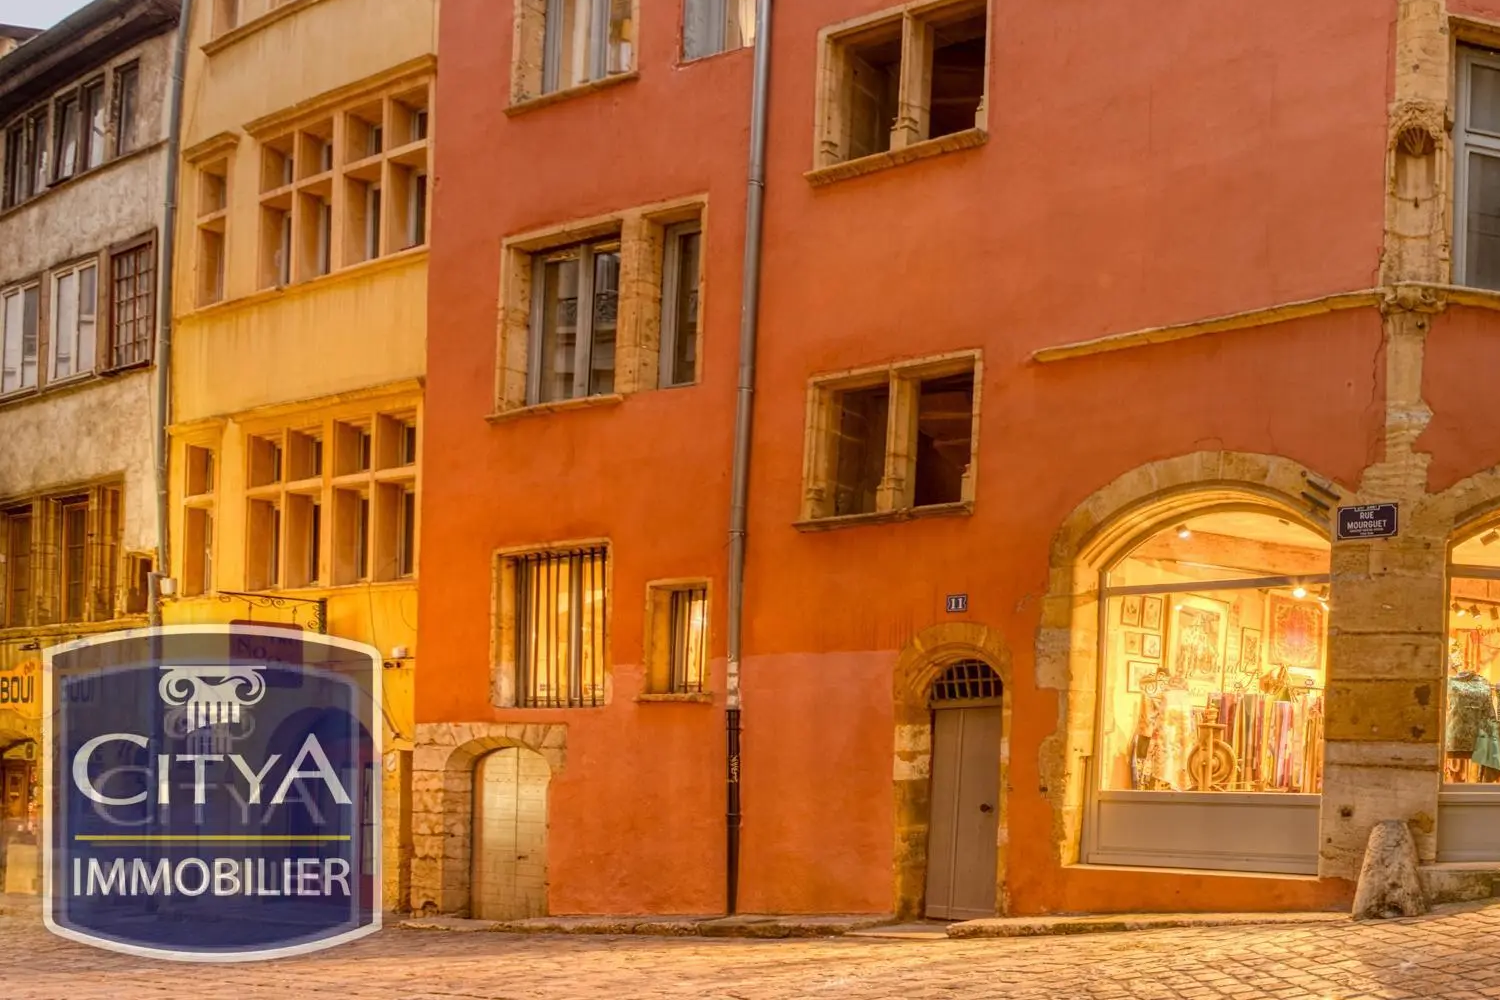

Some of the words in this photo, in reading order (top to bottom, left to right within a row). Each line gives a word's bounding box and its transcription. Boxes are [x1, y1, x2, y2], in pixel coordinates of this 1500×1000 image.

[1359, 511, 1375, 519] RUE
[1346, 519, 1387, 530] MOURGUET
[950, 598, 963, 609] 11
[0, 675, 34, 703] BOUI
